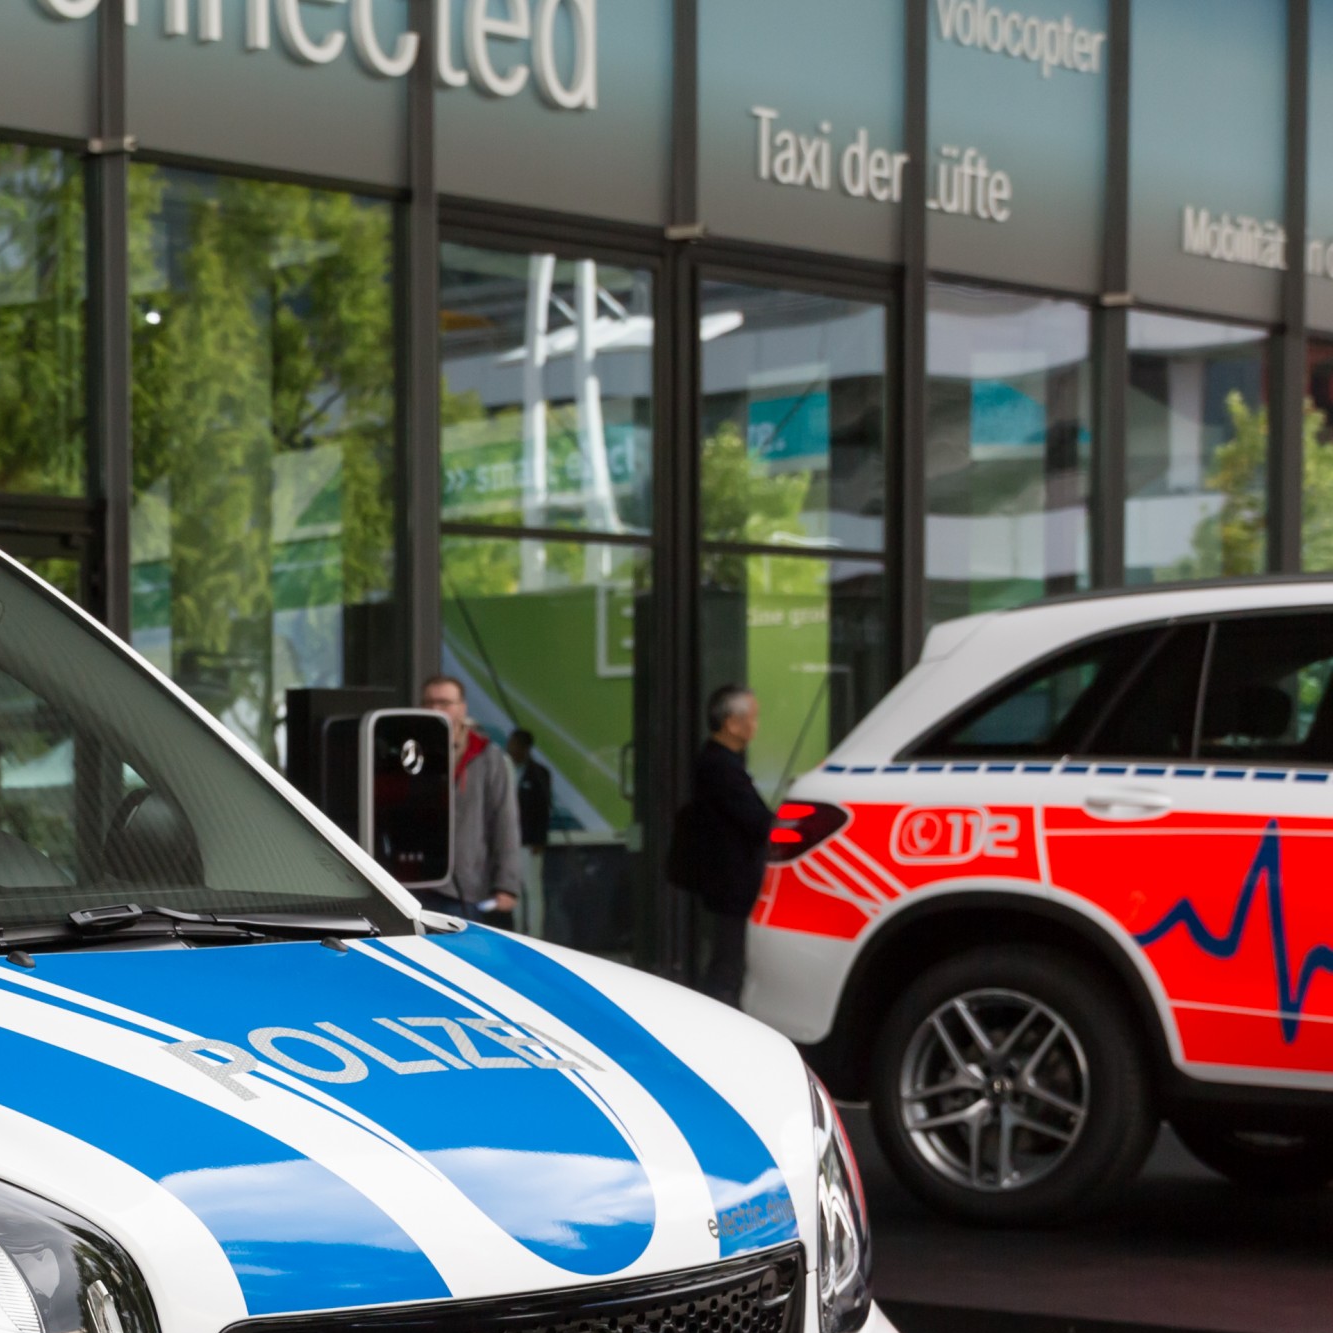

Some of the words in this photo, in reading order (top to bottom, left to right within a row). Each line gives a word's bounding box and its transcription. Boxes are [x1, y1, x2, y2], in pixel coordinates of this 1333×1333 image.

[43, 0, 598, 110] ected
[937, 0, 1107, 79] Volocopter
[750, 105, 832, 192] Taxi
[841, 127, 910, 204] der
[946, 813, 1021, 858] 112
[159, 1016, 607, 1101] POLIZEI
